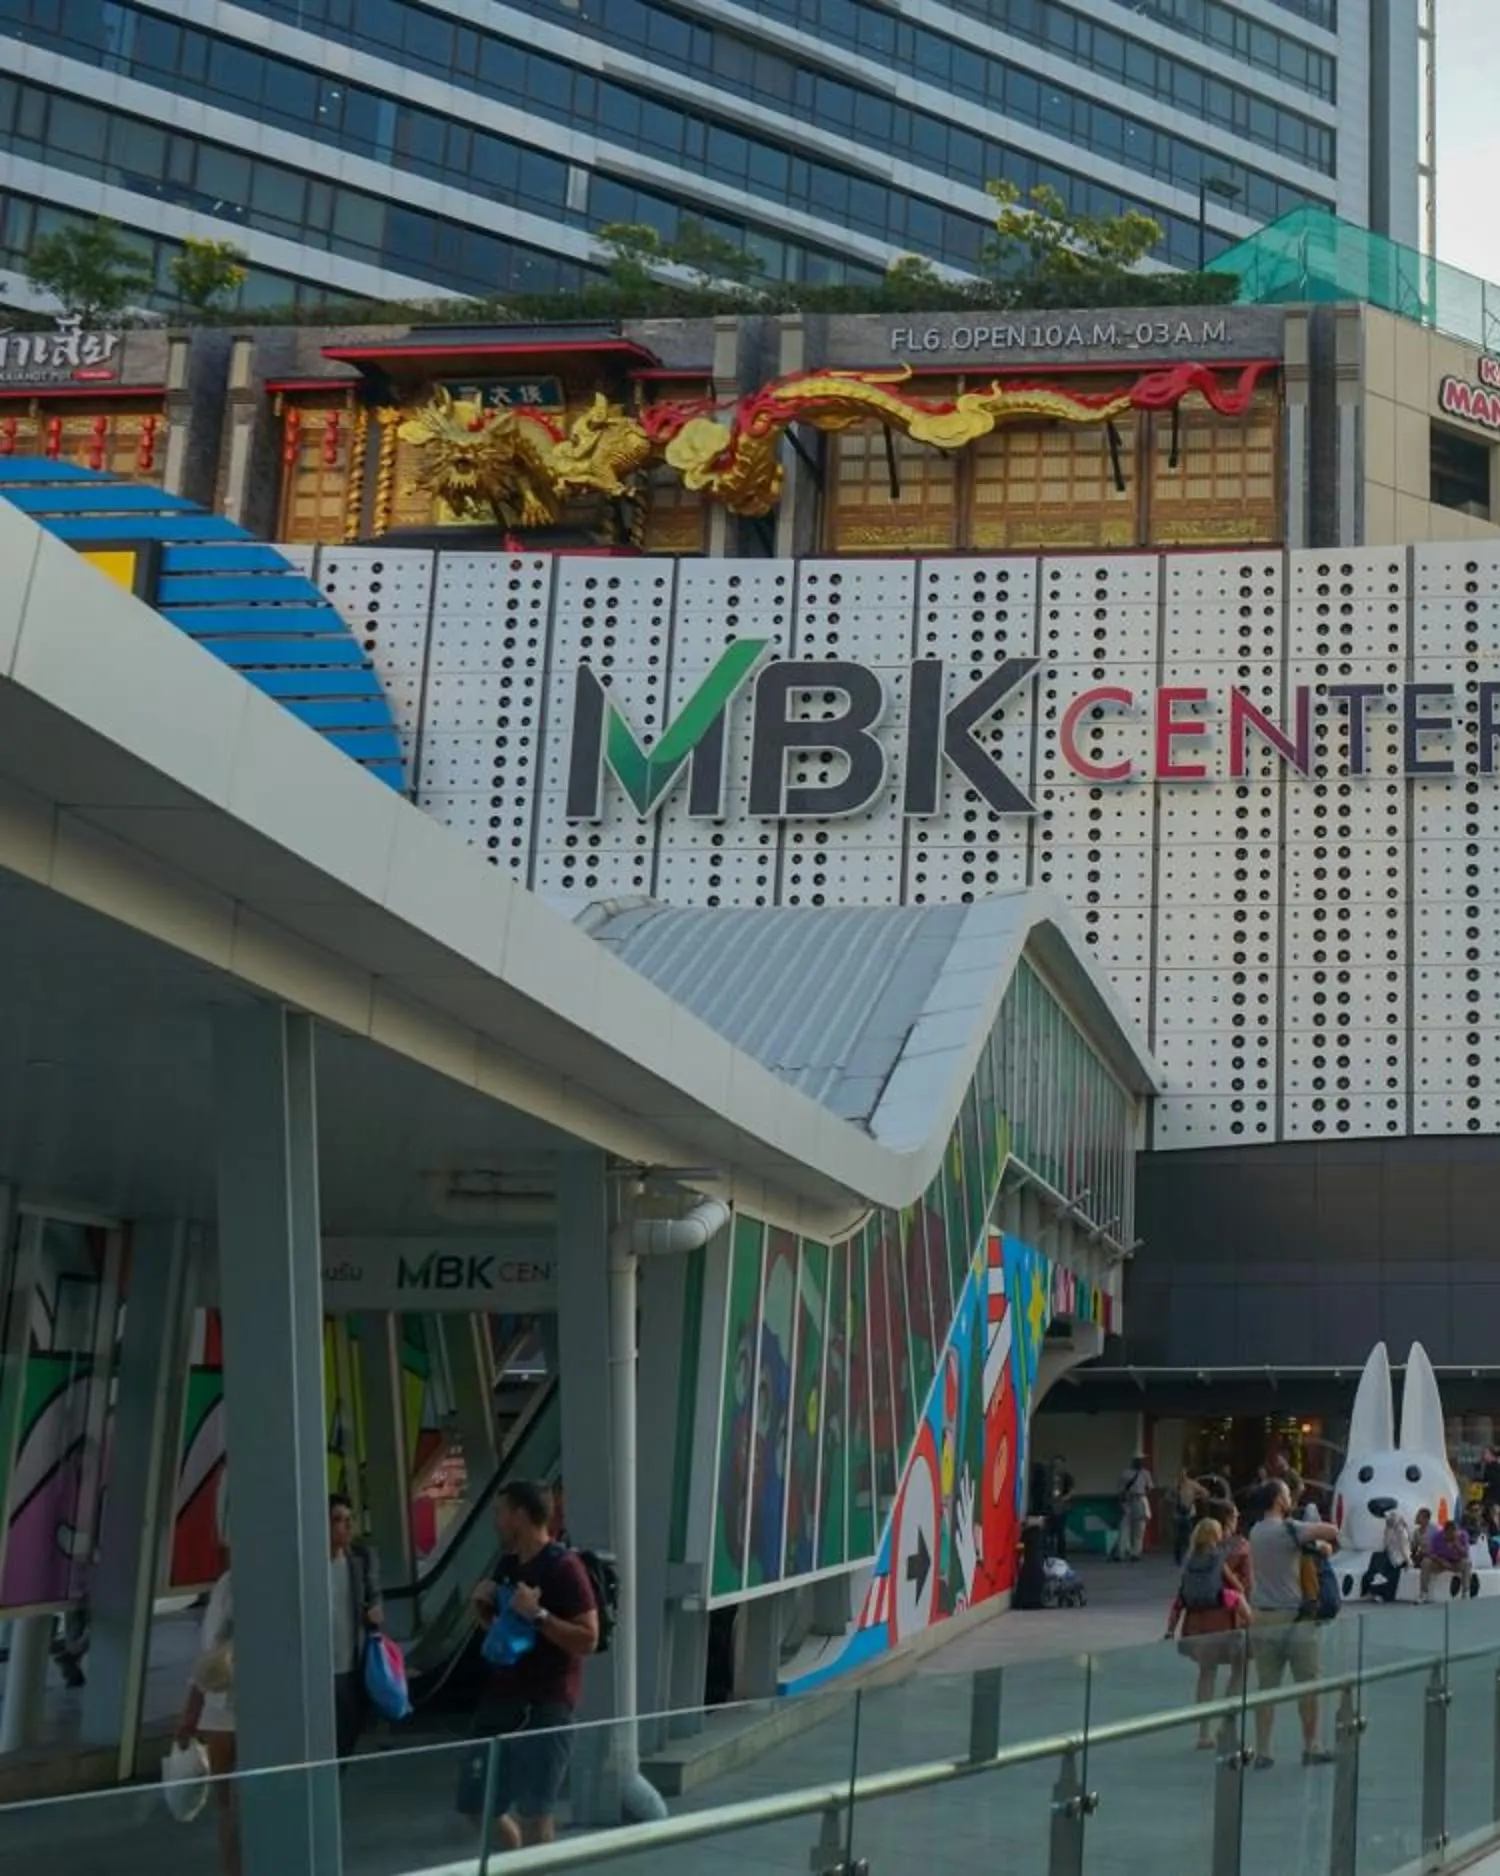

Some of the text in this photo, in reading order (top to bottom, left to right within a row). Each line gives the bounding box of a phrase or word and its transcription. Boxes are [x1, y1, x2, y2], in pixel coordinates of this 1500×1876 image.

[951, 325, 1026, 350] OPEN
[564, 638, 1045, 820] MBK
[397, 1250, 497, 1291] MBK
